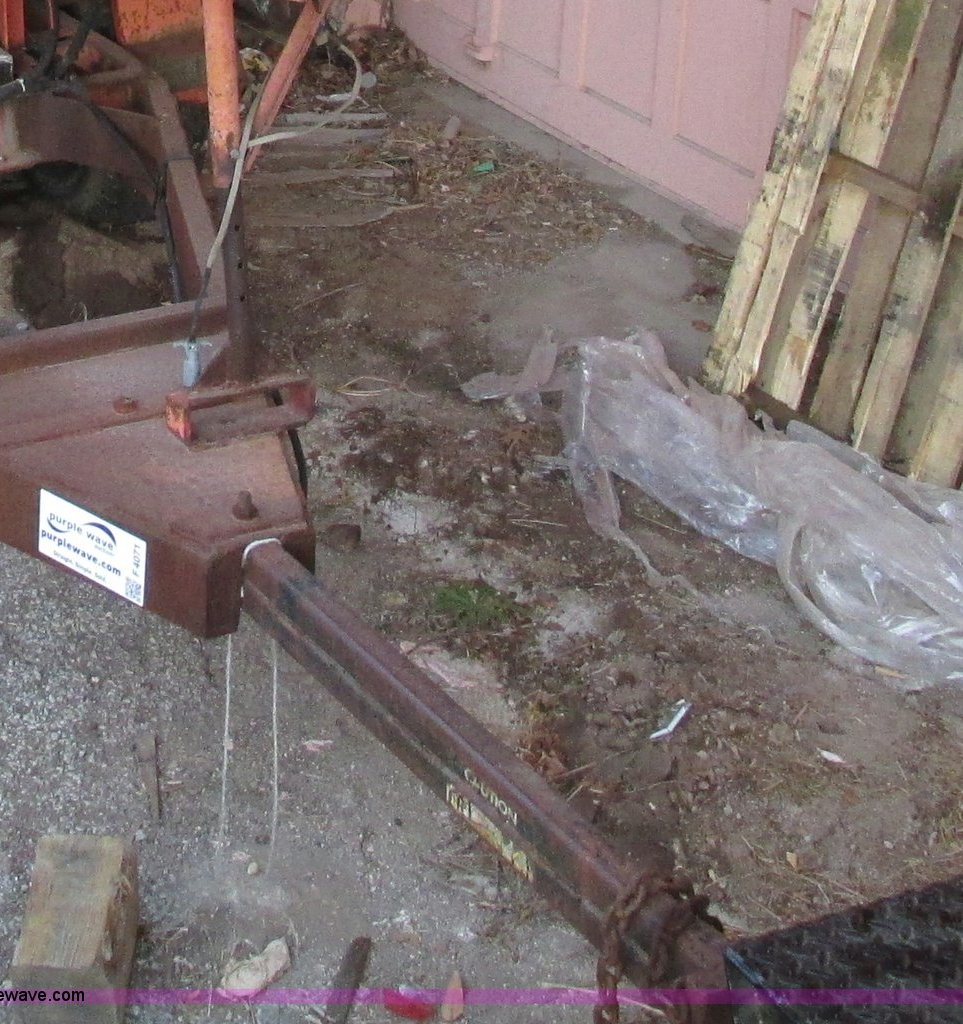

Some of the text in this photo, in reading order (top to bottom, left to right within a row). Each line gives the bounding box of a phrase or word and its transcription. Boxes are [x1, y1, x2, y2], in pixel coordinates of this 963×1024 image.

[41, 528, 121, 576] purplewave.com
[49, 512, 114, 551] purple wave
